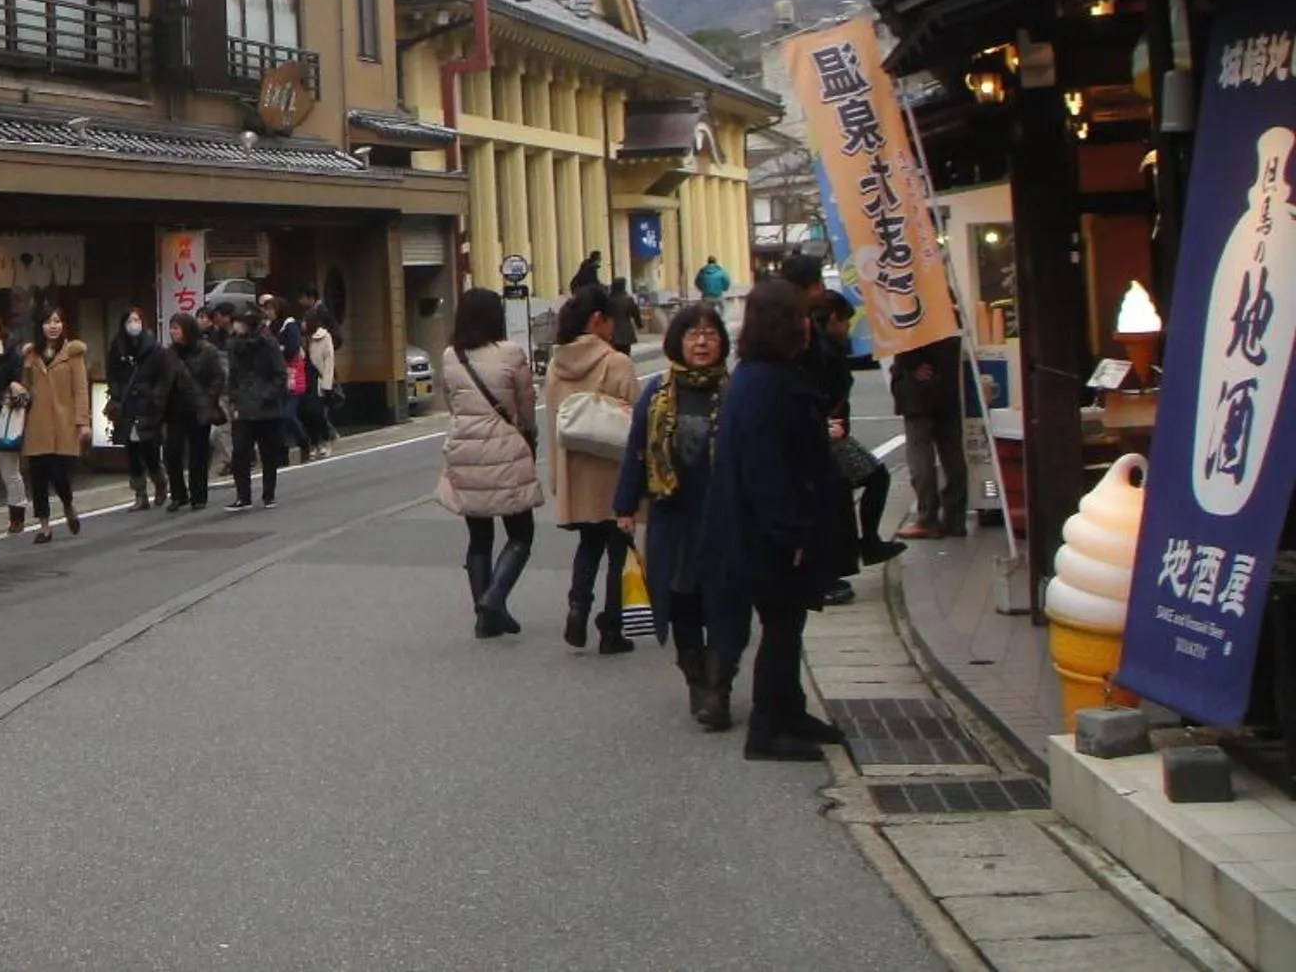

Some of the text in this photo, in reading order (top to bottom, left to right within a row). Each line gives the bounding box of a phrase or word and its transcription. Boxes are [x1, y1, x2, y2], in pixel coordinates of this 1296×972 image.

[1217, 30, 1296, 89] 城崎地
[811, 41, 924, 329] 温泉たまご
[1157, 537, 1256, 618] 地酒屋
